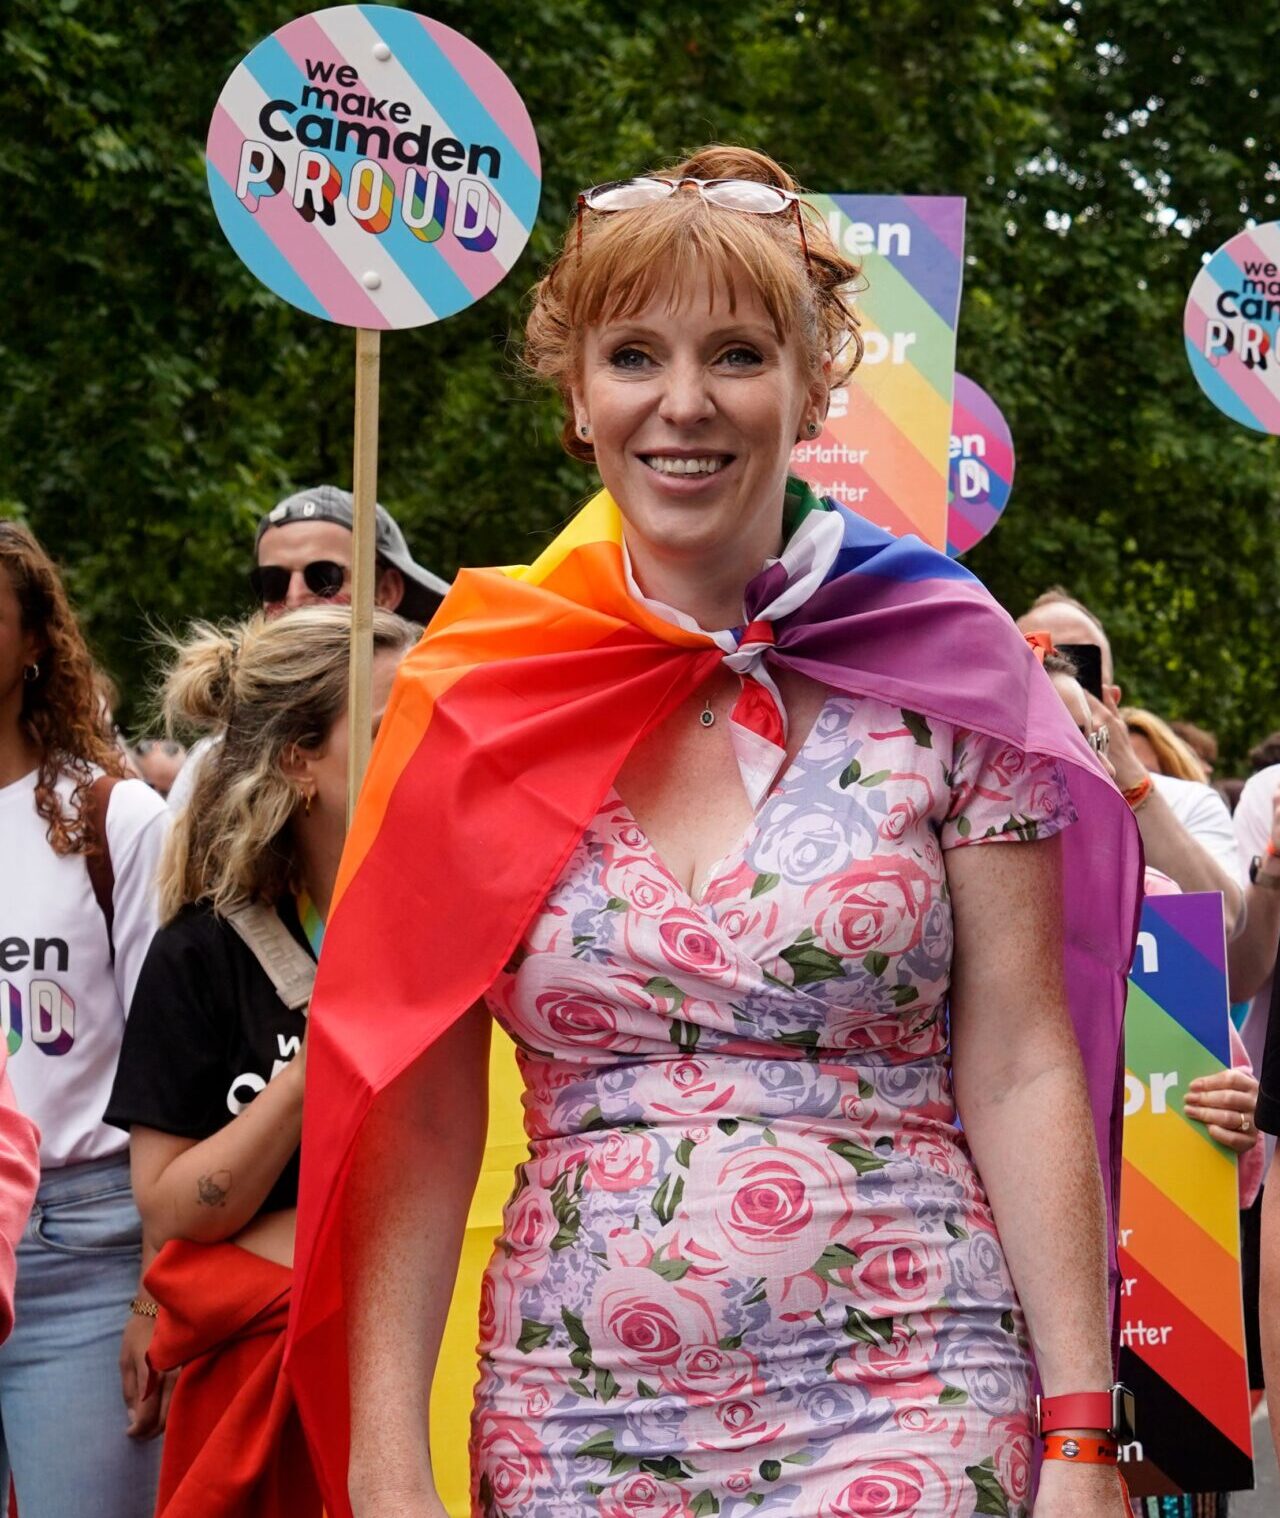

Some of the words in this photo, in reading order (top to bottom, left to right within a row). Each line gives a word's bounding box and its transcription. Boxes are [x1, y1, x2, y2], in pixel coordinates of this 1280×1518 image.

[305, 59, 359, 88] we
[300, 84, 412, 124] make
[258, 99, 502, 180] Camden
[235, 139, 502, 252] PROUD
[1243, 260, 1279, 278] we
[0, 936, 69, 972] en
[1119, 1319, 1174, 1348] tter
